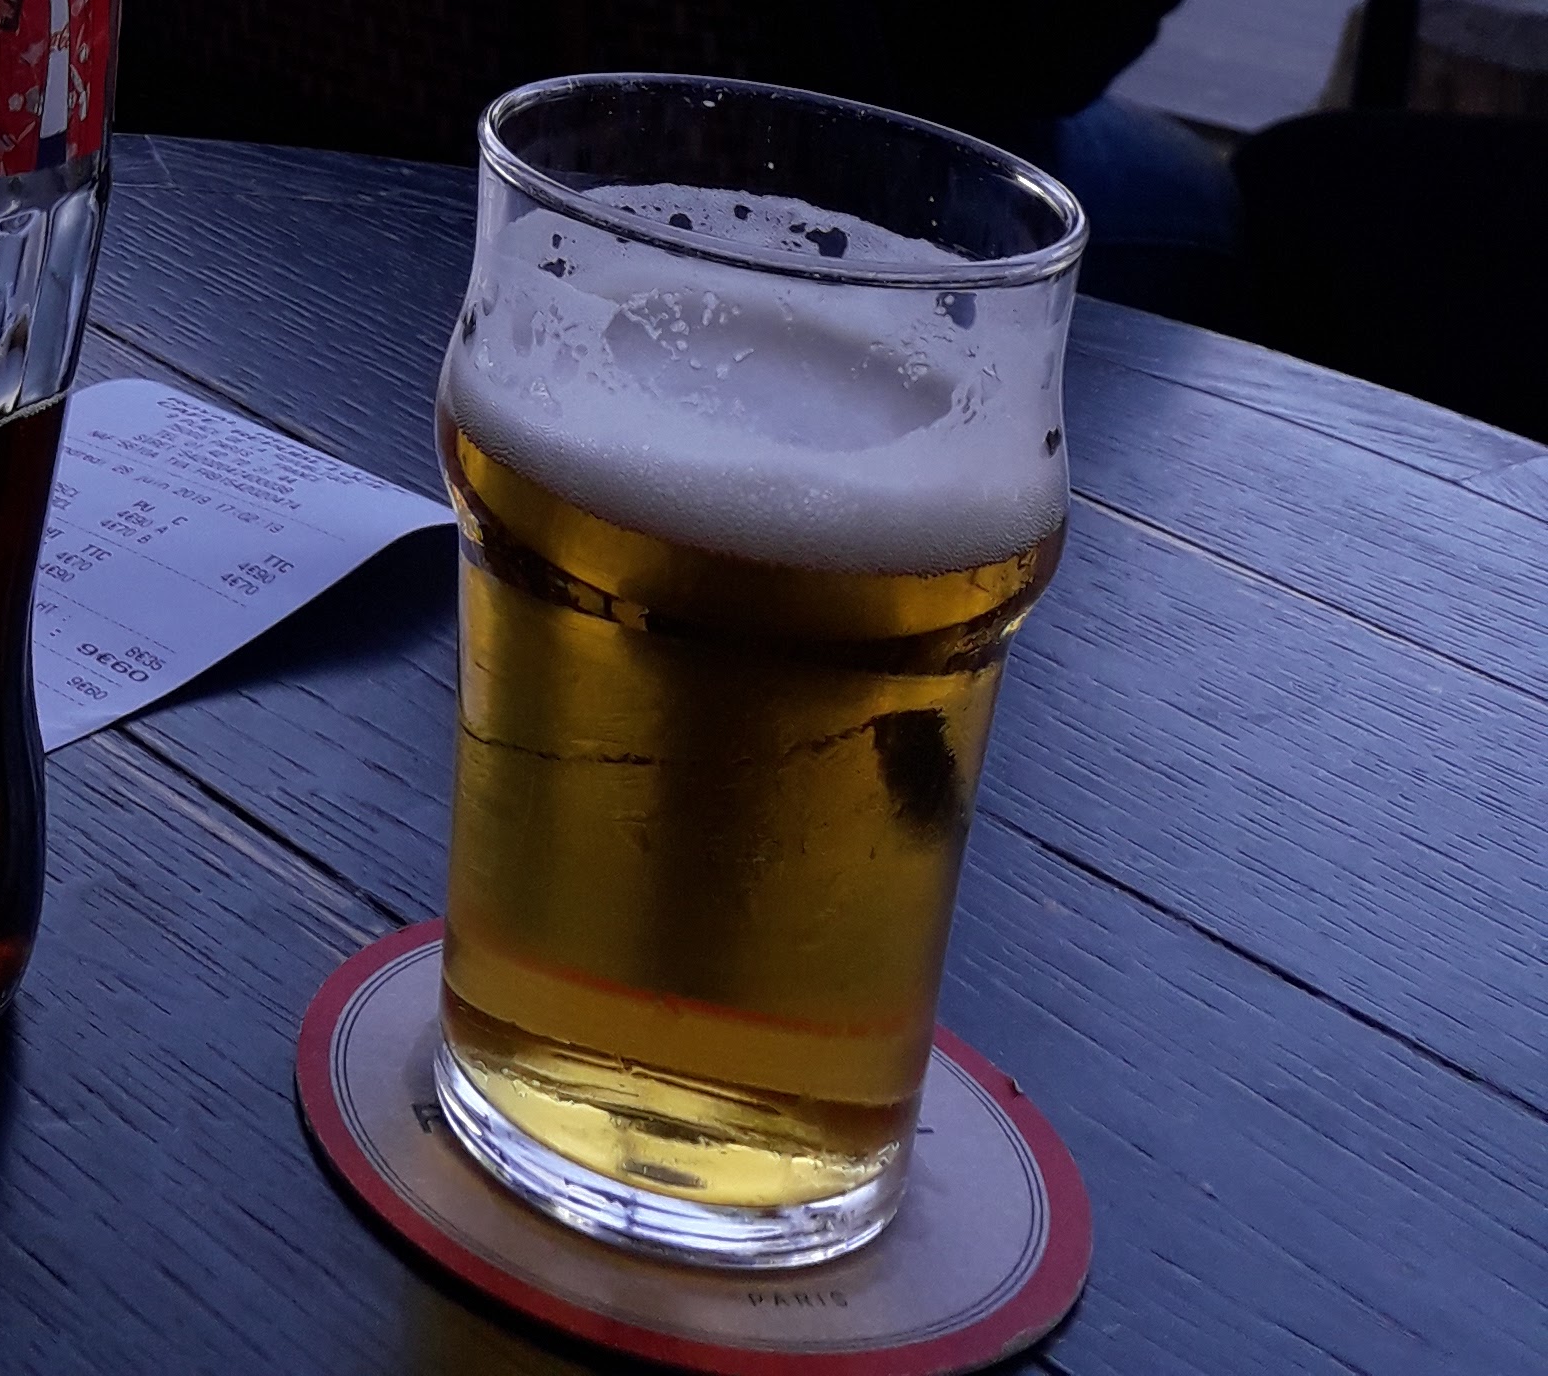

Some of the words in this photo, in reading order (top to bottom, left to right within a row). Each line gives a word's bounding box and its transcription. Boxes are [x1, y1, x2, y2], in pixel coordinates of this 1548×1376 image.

[172, 487, 212, 504] 2019
[80, 544, 113, 561] TTC
[99, 519, 138, 538] 4€70
[220, 573, 259, 596] 4€70
[116, 510, 154, 528] 4€90
[237, 563, 276, 584] 4€90
[171, 515, 189, 526] C
[263, 554, 295, 574] TTC
[56, 551, 93, 572] 4€70
[75, 643, 150, 682] 9€60
[66, 675, 109, 701] 9€60
[747, 1290, 849, 1309] PARIS
